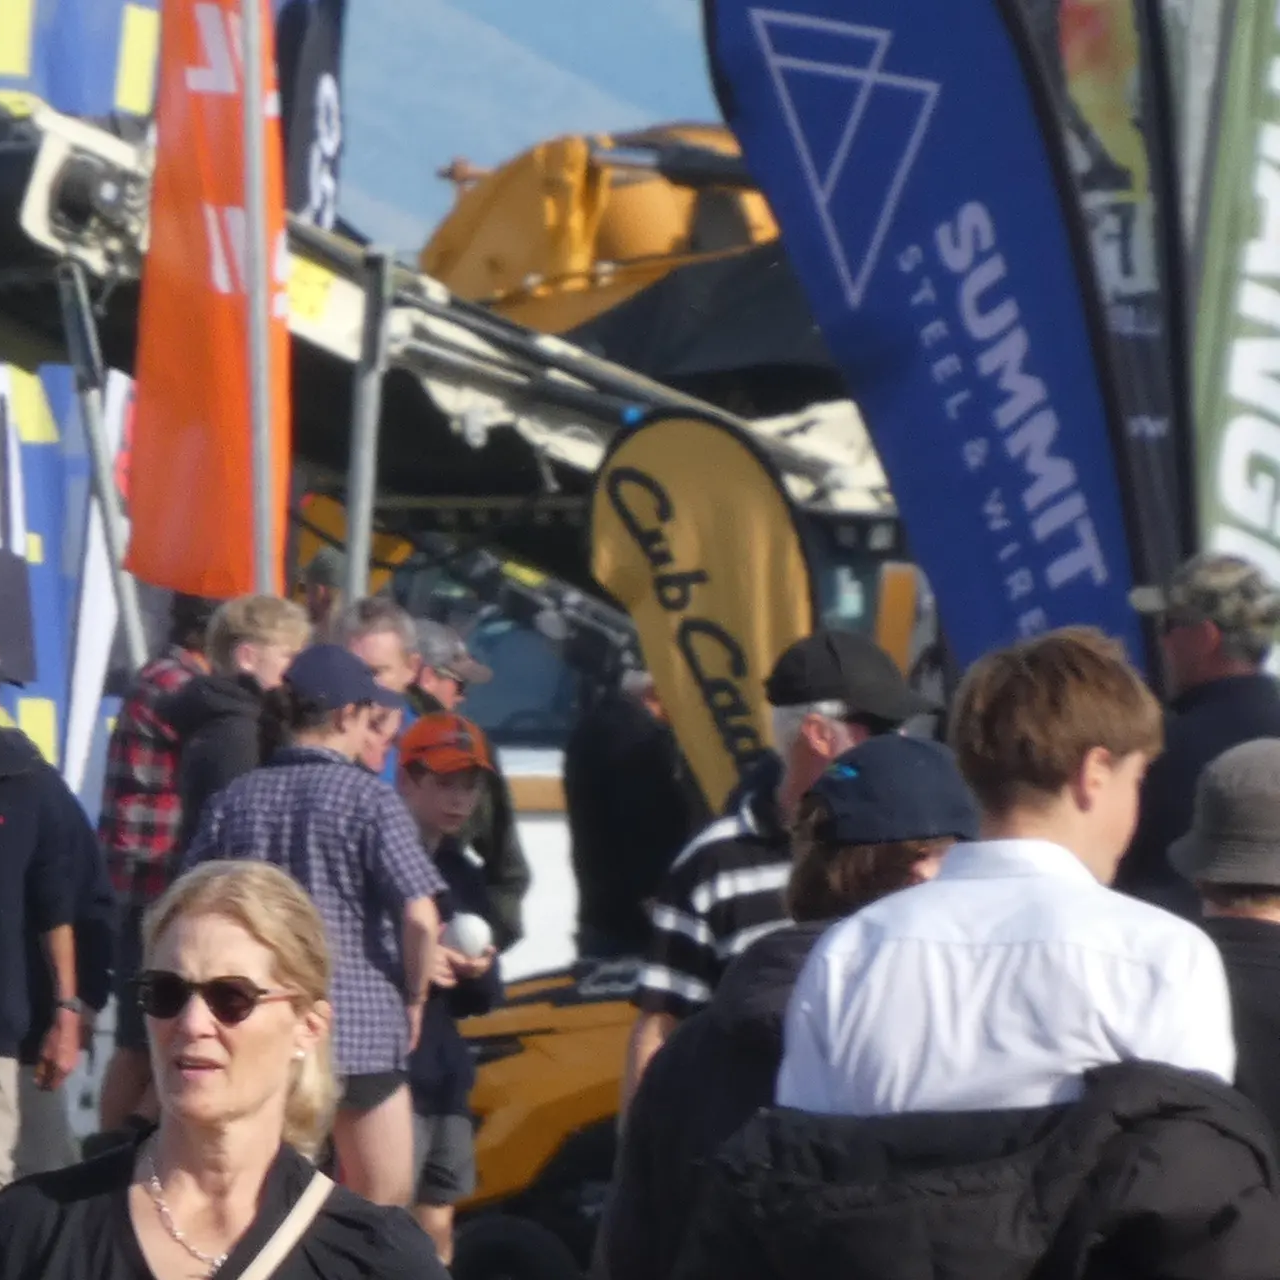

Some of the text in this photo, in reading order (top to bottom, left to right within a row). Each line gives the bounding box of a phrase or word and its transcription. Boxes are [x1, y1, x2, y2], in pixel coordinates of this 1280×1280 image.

[897, 243, 961, 421] STEEL
[962, 437, 989, 471] &
[935, 200, 1108, 590] SUMMIT
[606, 467, 709, 612] Cub
